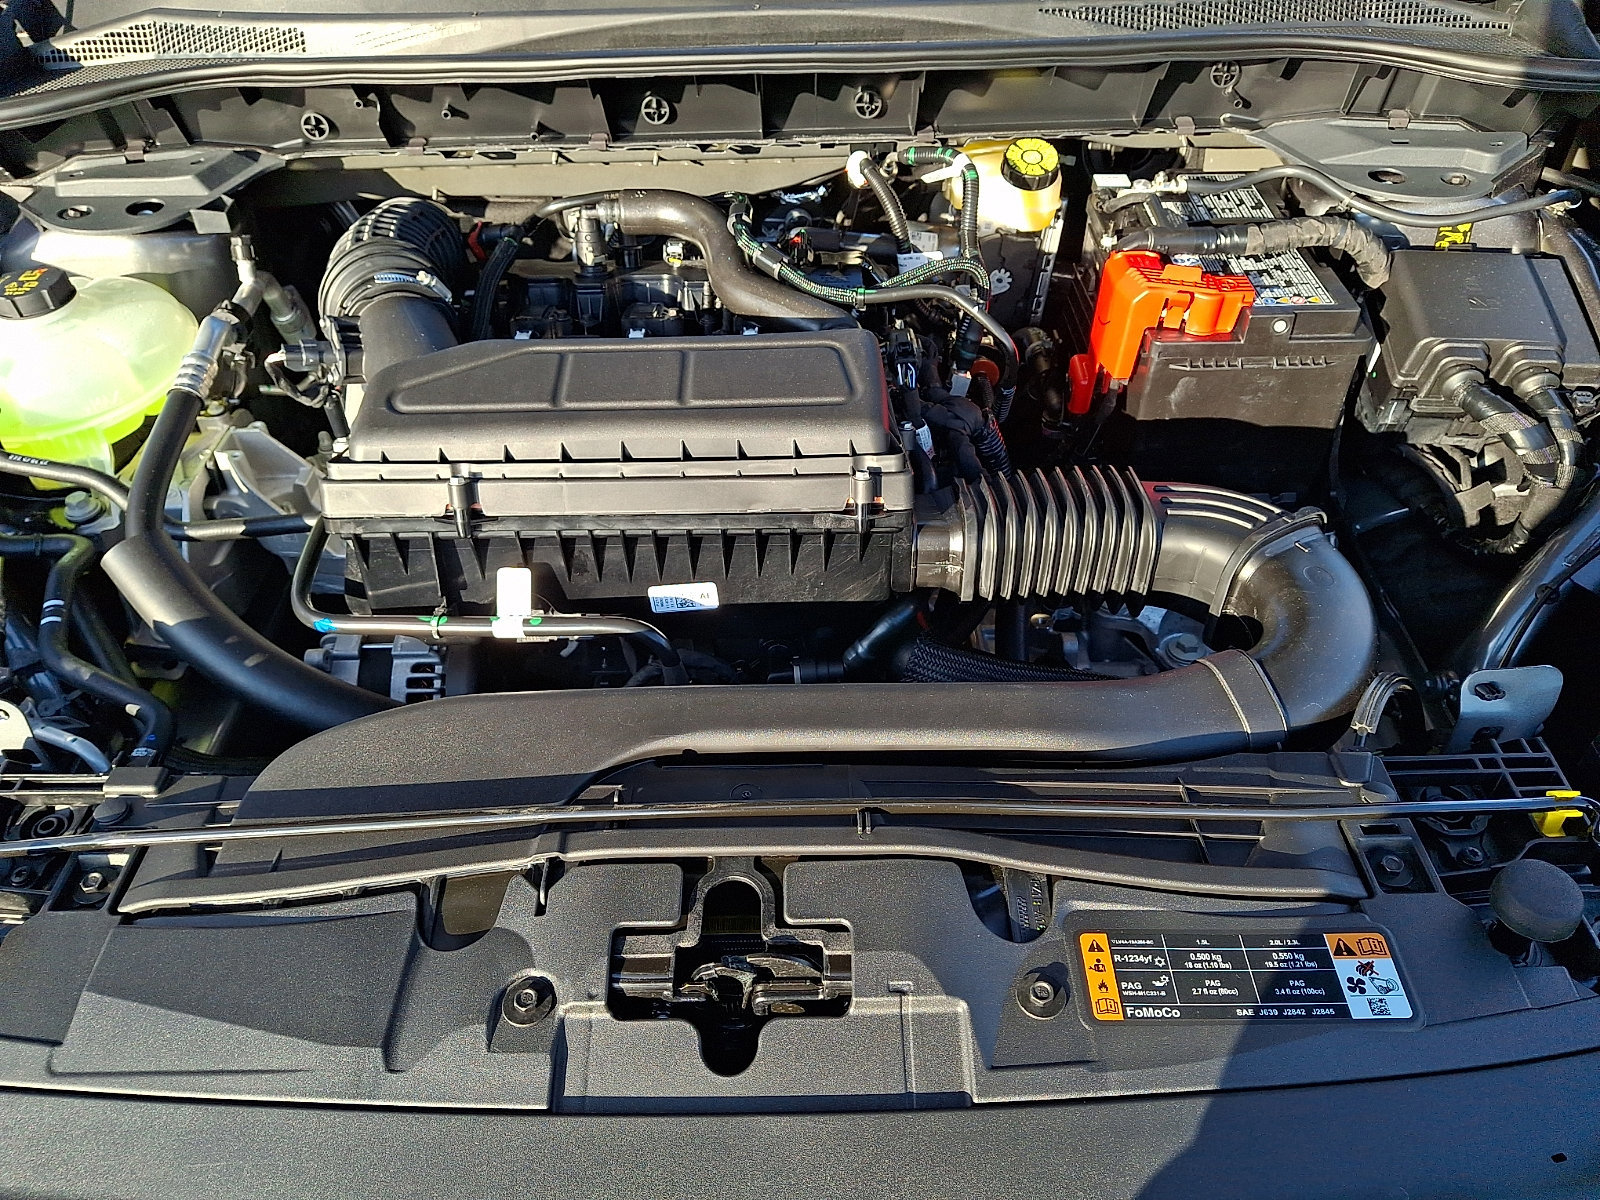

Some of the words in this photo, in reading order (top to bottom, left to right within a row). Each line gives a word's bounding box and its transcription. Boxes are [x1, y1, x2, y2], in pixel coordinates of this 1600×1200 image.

[1114, 954, 1153, 964] R-1234yf
[1189, 952, 1210, 960] 0.500
[1211, 953, 1222, 962] kg
[1272, 952, 1293, 960] 0.550
[1294, 952, 1304, 961] kg
[1203, 961, 1218, 969] (1.10
[1219, 961, 1232, 970] lbs)
[1288, 961, 1303, 969] (1.21
[1304, 961, 1318, 969] lbs)
[1121, 982, 1142, 990] PAG
[1301, 988, 1325, 996] (100cc)
[1126, 1006, 1181, 1018] FoMoCo
[1236, 1008, 1255, 1016] SAE
[1259, 1008, 1278, 1016] J639
[1282, 1008, 1306, 1016] J2842
